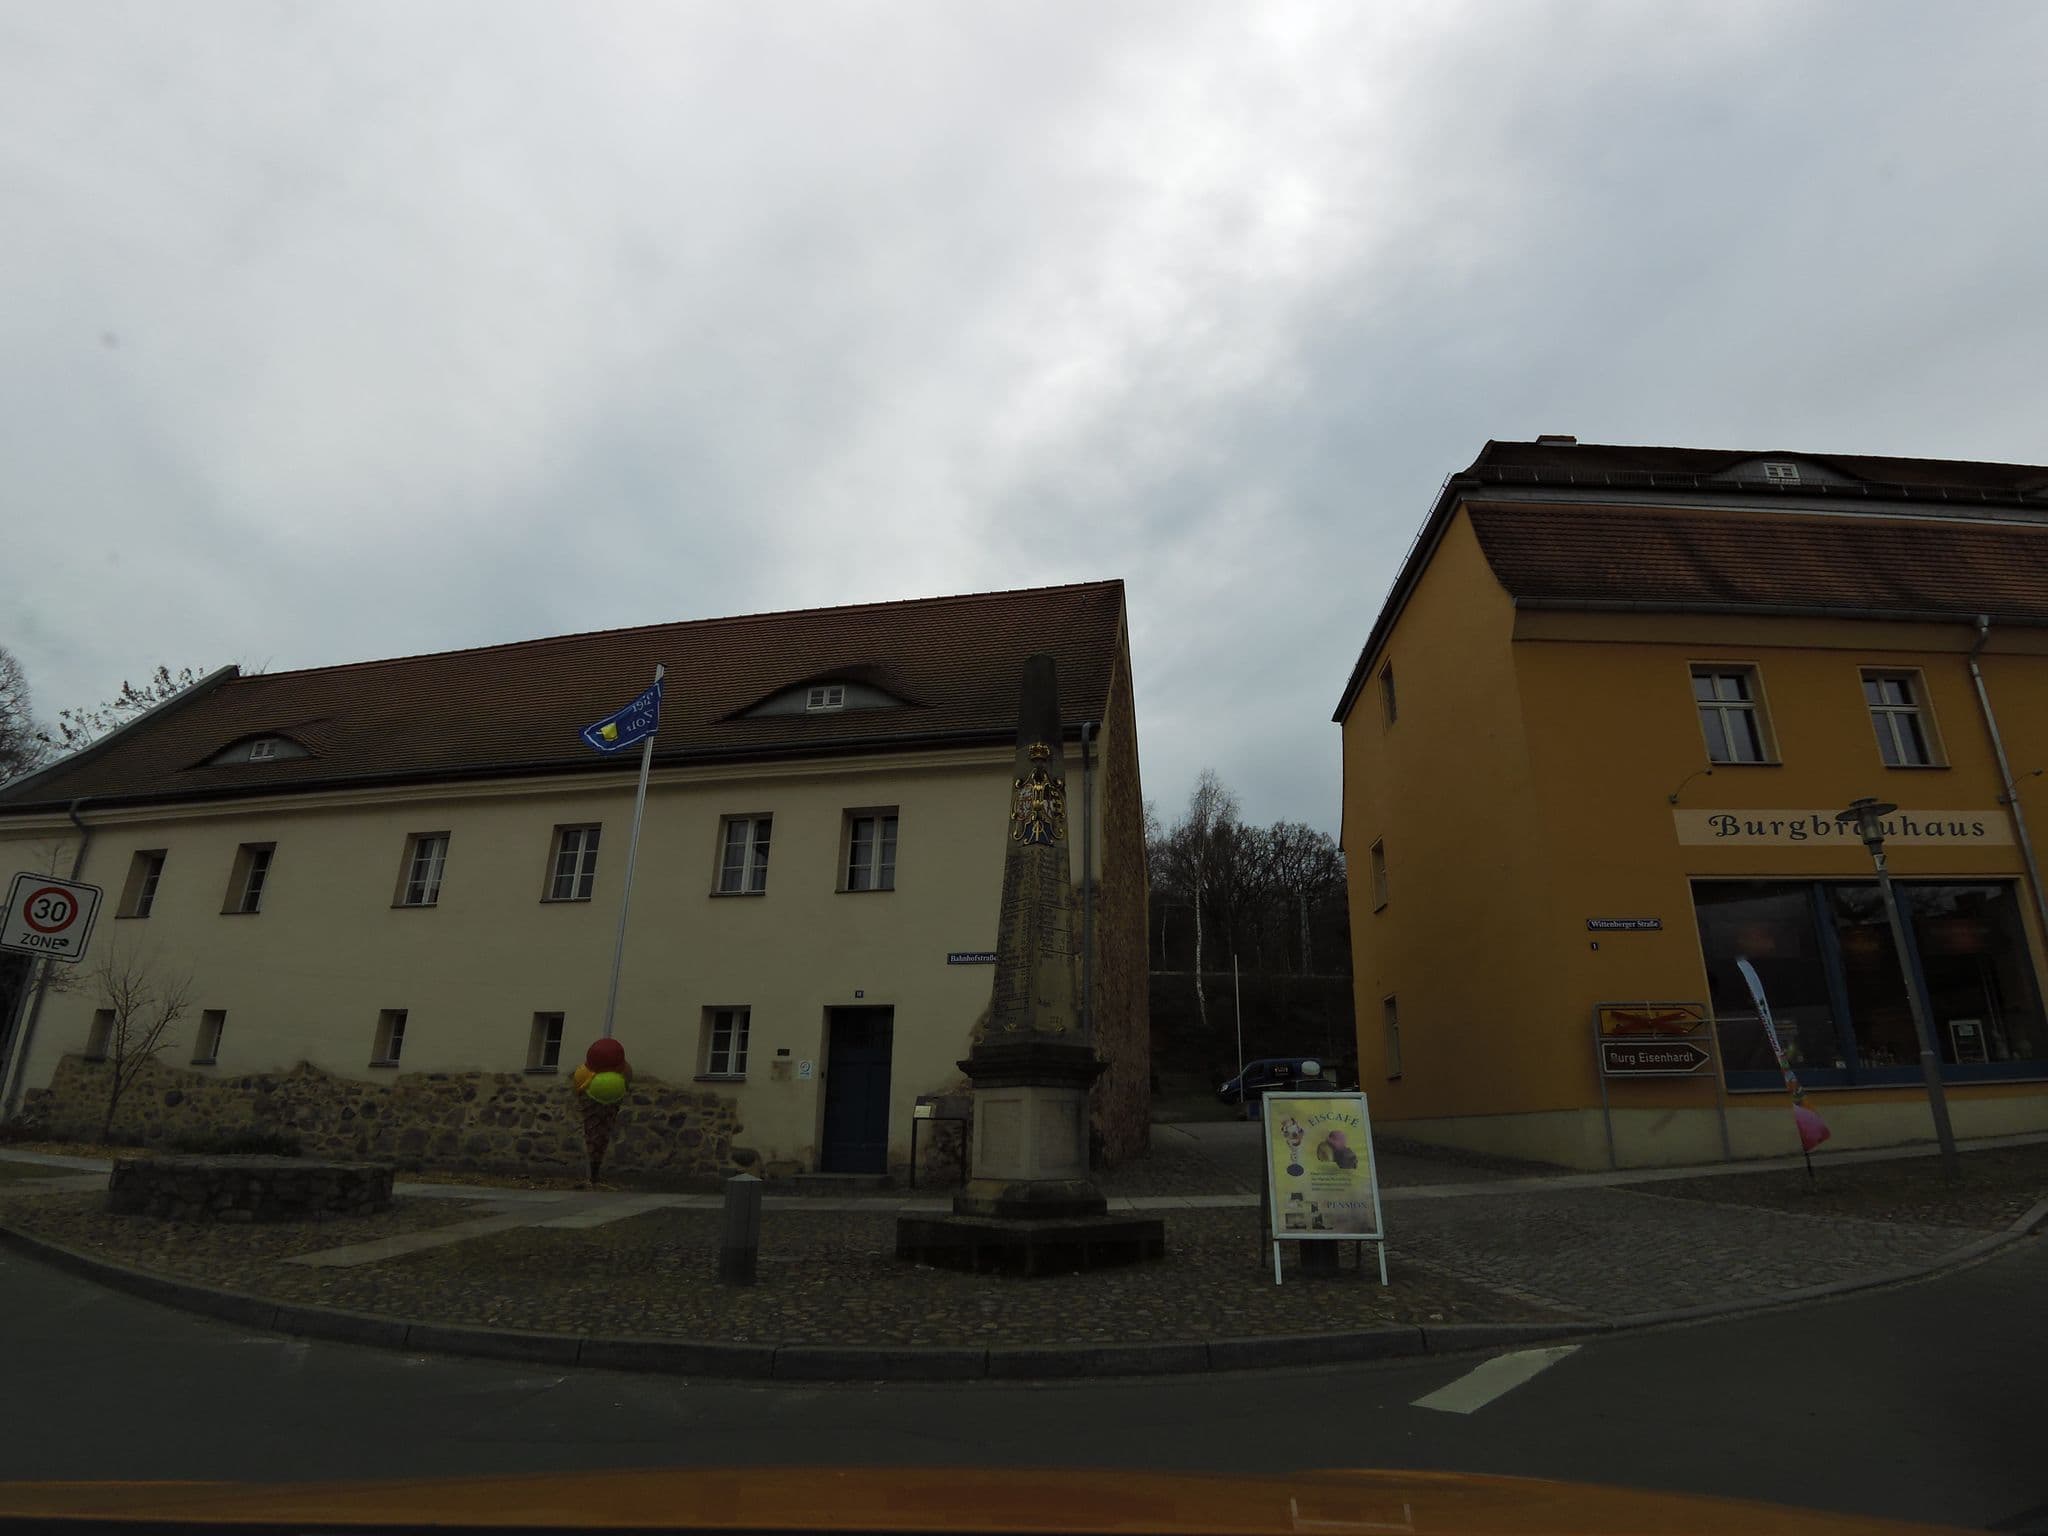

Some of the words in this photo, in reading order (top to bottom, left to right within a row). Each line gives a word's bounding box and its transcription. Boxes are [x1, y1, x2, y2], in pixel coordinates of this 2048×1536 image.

[34, 898, 67, 922] 30
[20, 932, 63, 950] ZONE
[1610, 1052, 1635, 1065] Burg
[1638, 1052, 1694, 1063] Eisenhardt
